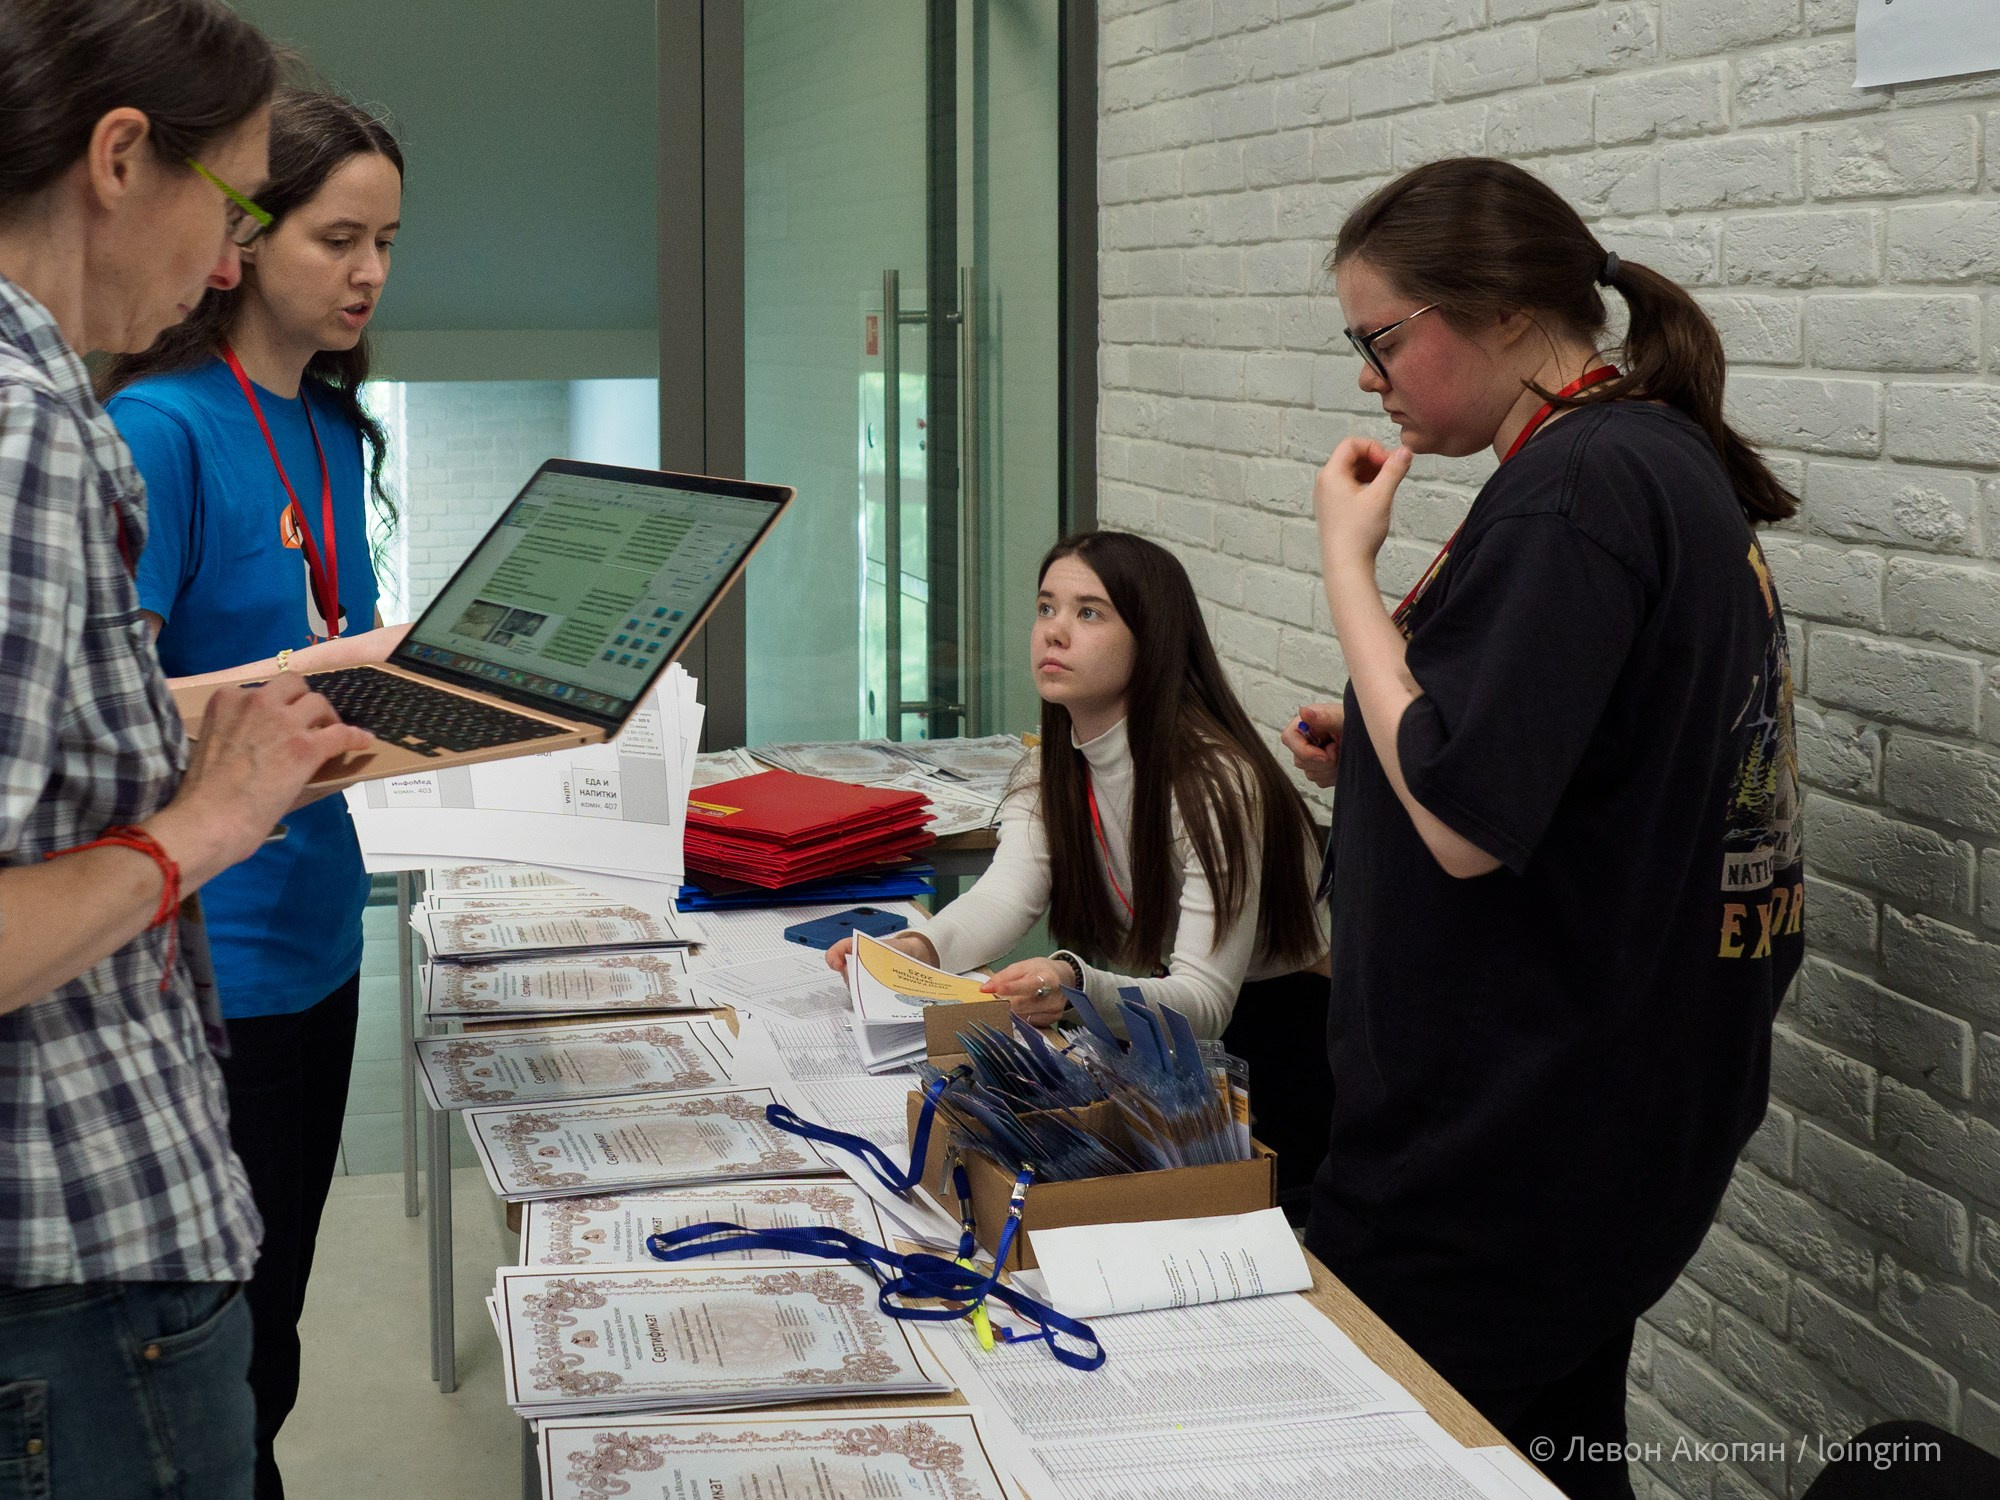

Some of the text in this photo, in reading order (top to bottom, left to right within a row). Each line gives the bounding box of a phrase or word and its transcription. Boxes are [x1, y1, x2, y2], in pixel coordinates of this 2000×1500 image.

[585, 777, 609, 787] ЕДА И
[579, 788, 617, 799] НАПИТКИ
[603, 802, 618, 810] 407
[593, 1132, 619, 1165] Сертификат
[644, 1313, 669, 1364] Сертификат
